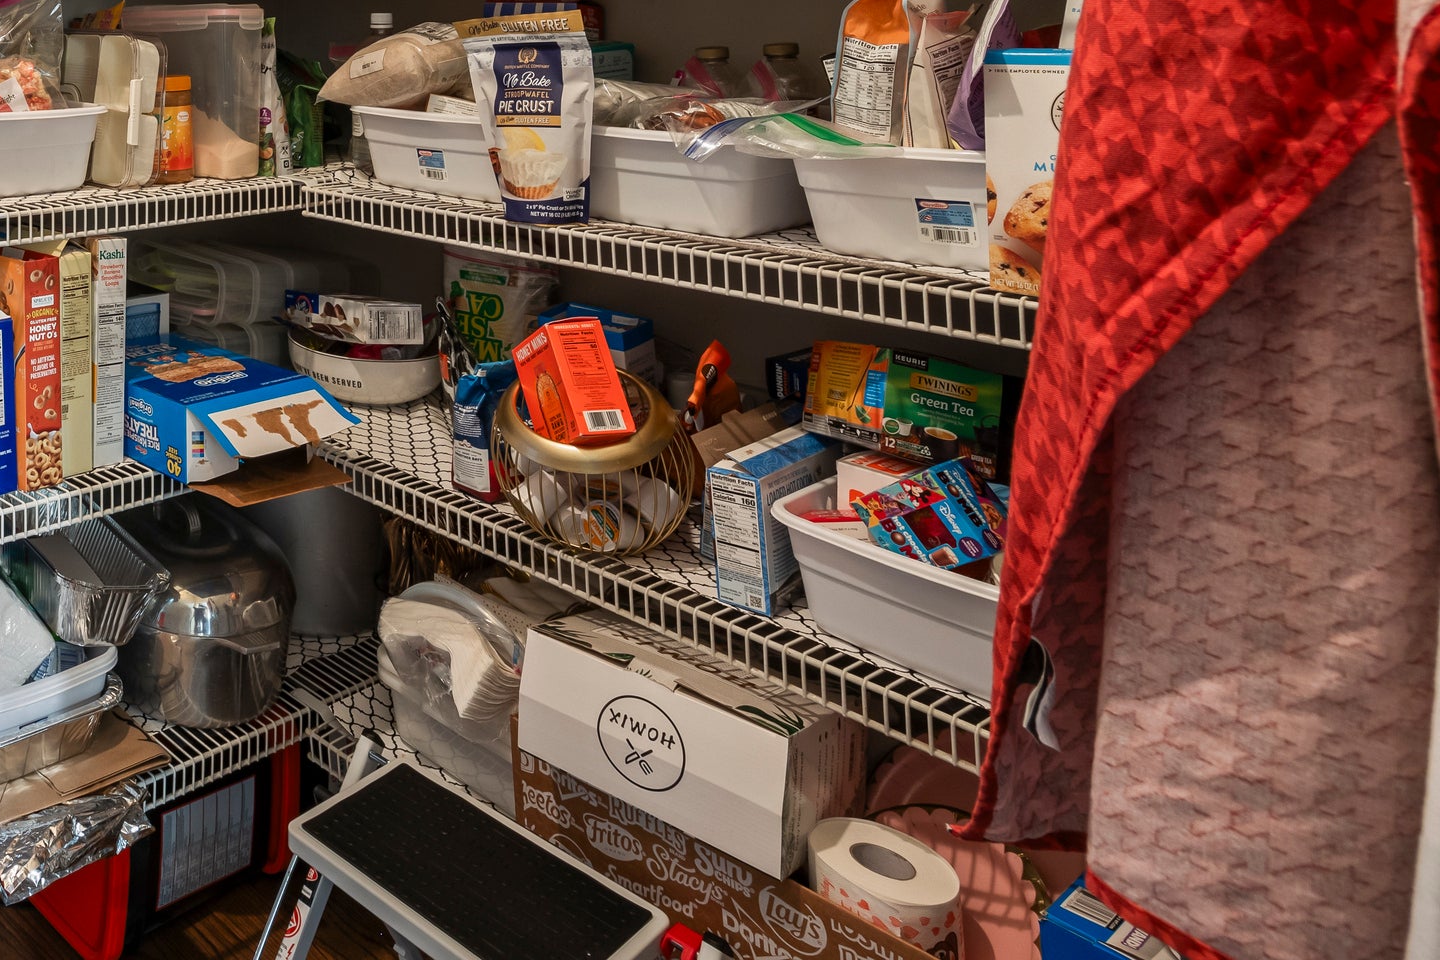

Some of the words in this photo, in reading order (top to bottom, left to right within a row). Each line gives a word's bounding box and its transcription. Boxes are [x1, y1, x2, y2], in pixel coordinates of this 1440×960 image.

[500, 19, 539, 34] GLUTEN
[542, 17, 570, 31] FREE
[844, 37, 875, 50] Nutrition
[877, 43, 898, 51] Facts
[520, 71, 551, 87] Bake
[504, 90, 550, 99] STROOPWAFEL
[499, 100, 513, 113] PIE
[515, 100, 554, 113] CRUST
[99, 249, 124, 260] Kashi
[101, 263, 124, 271] Strawberry
[105, 280, 120, 288] Loops
[30, 323, 57, 334] HONEY
[30, 333, 45, 342] NUT
[895, 353, 927, 367] KEURIG
[312, 370, 329, 384] BEEN
[332, 375, 363, 389] SERVED
[916, 376, 972, 397] TWININGS
[911, 392, 949, 410] Green
[951, 401, 974, 417] Tea
[885, 437, 896, 448] 12
[971, 454, 985, 463] GREEN
[741, 498, 755, 507] 160
[940, 502, 962, 535] Disney
[608, 706, 677, 752] HOMIX
[588, 817, 643, 857] Fritos
[694, 842, 753, 887] Sun
[646, 843, 724, 904] Stacy's
[714, 870, 751, 897] CHIPS
[608, 865, 695, 919] Smartfood
[764, 892, 822, 940] Lay's
